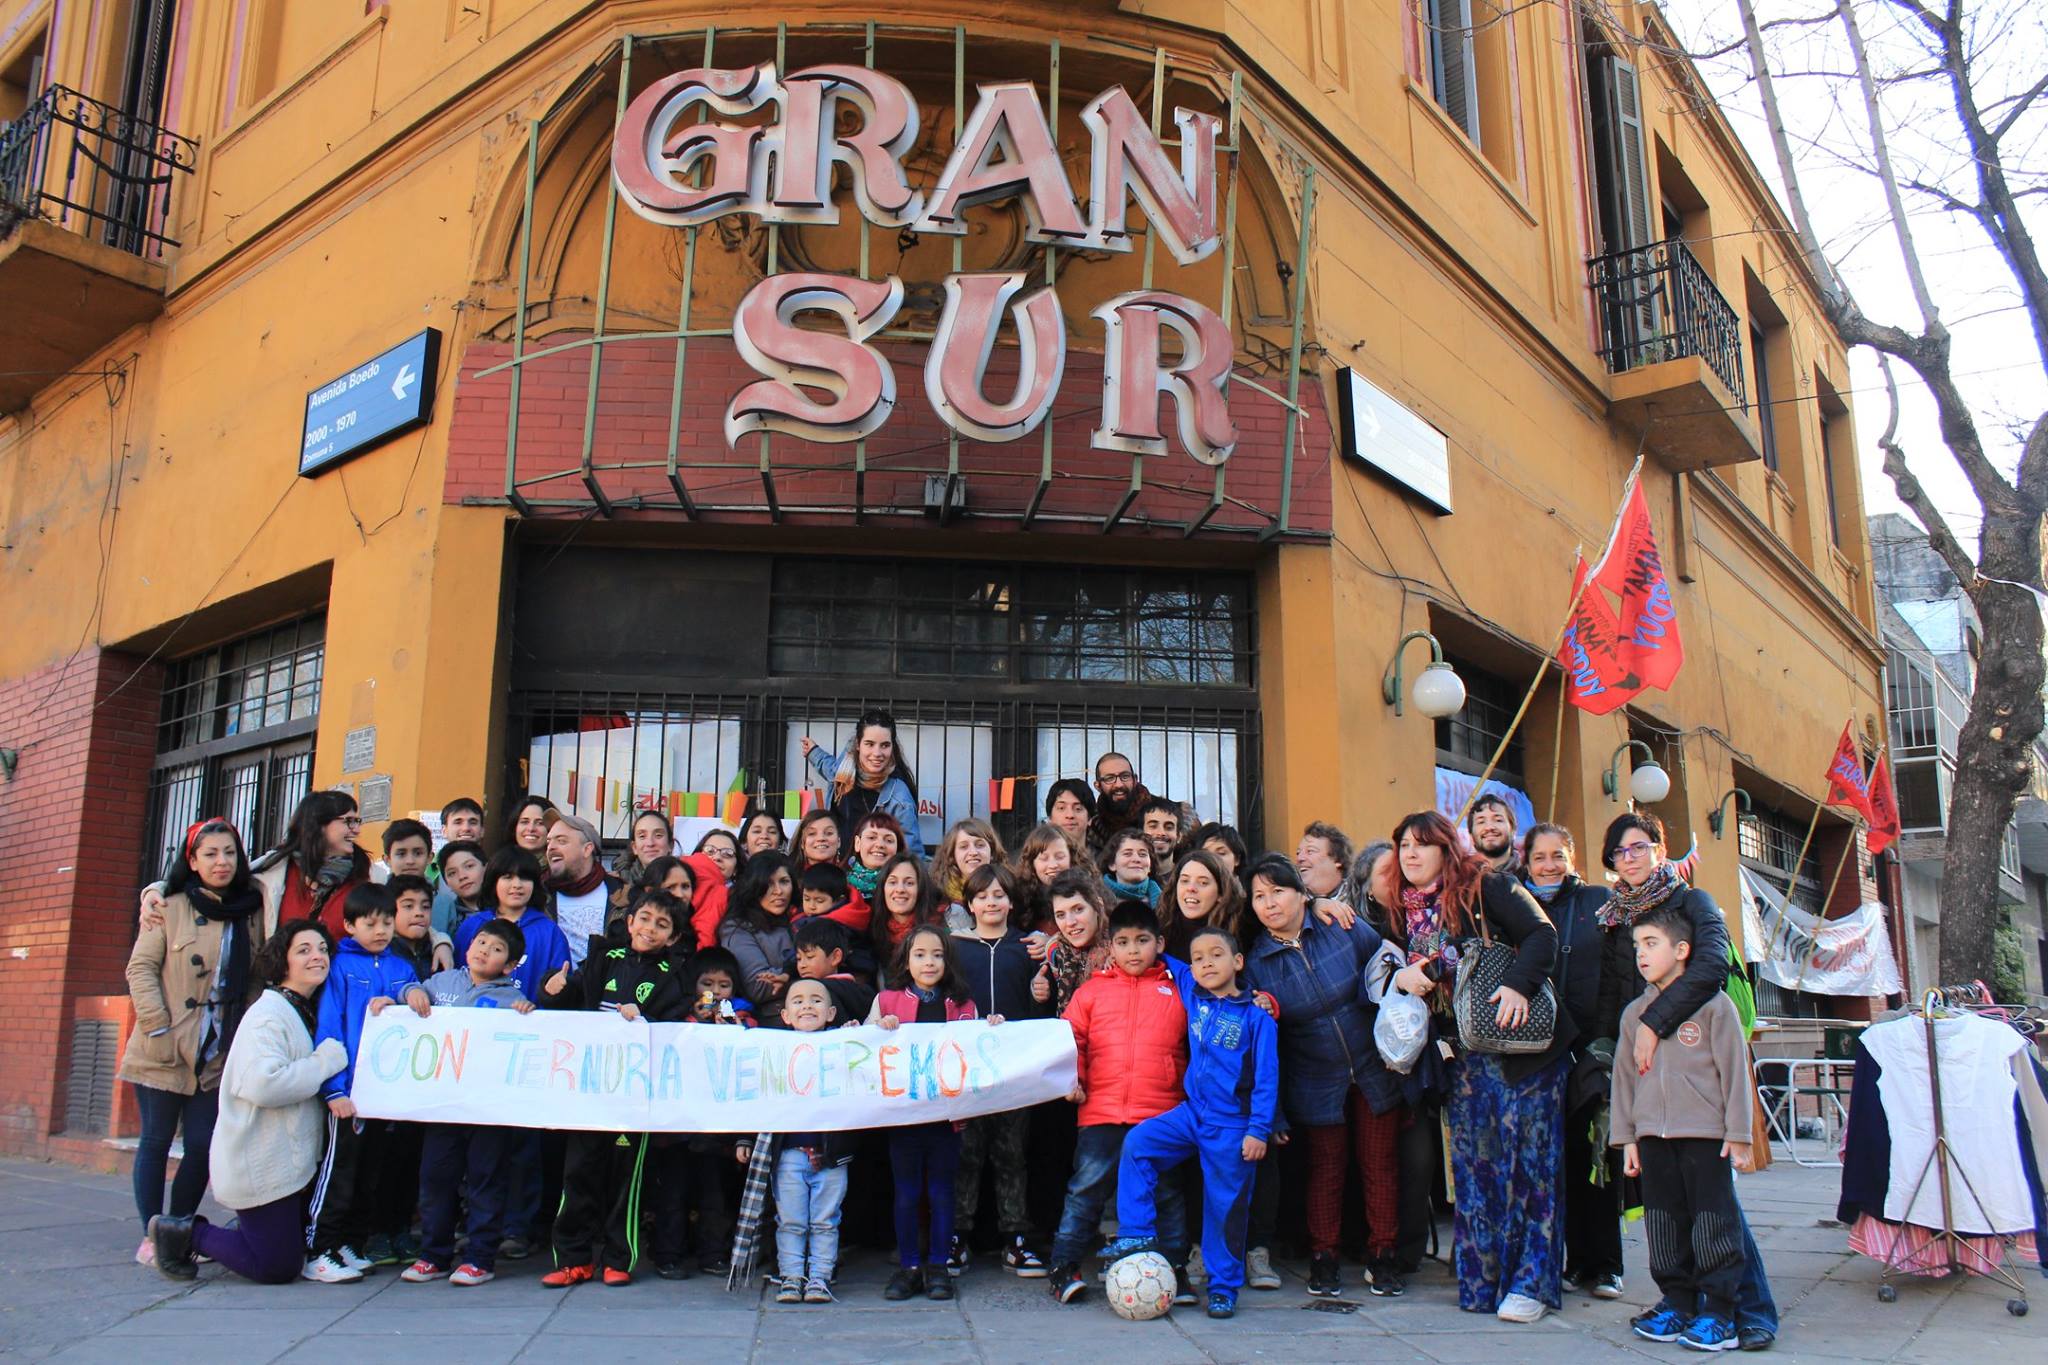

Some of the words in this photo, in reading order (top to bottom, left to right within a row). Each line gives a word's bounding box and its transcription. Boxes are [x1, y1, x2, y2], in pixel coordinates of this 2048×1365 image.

[611, 59, 1223, 266] GRAN
[310, 379, 347, 409] Avenida
[349, 362, 380, 389] Boedo
[724, 271, 1239, 467] SUR
[305, 425, 328, 448] 2000
[336, 410, 357, 432] 1970
[370, 1024, 469, 1084] CON
[494, 1031, 684, 1100] TERNURA
[703, 1032, 1002, 1102] VENCEREMOS
